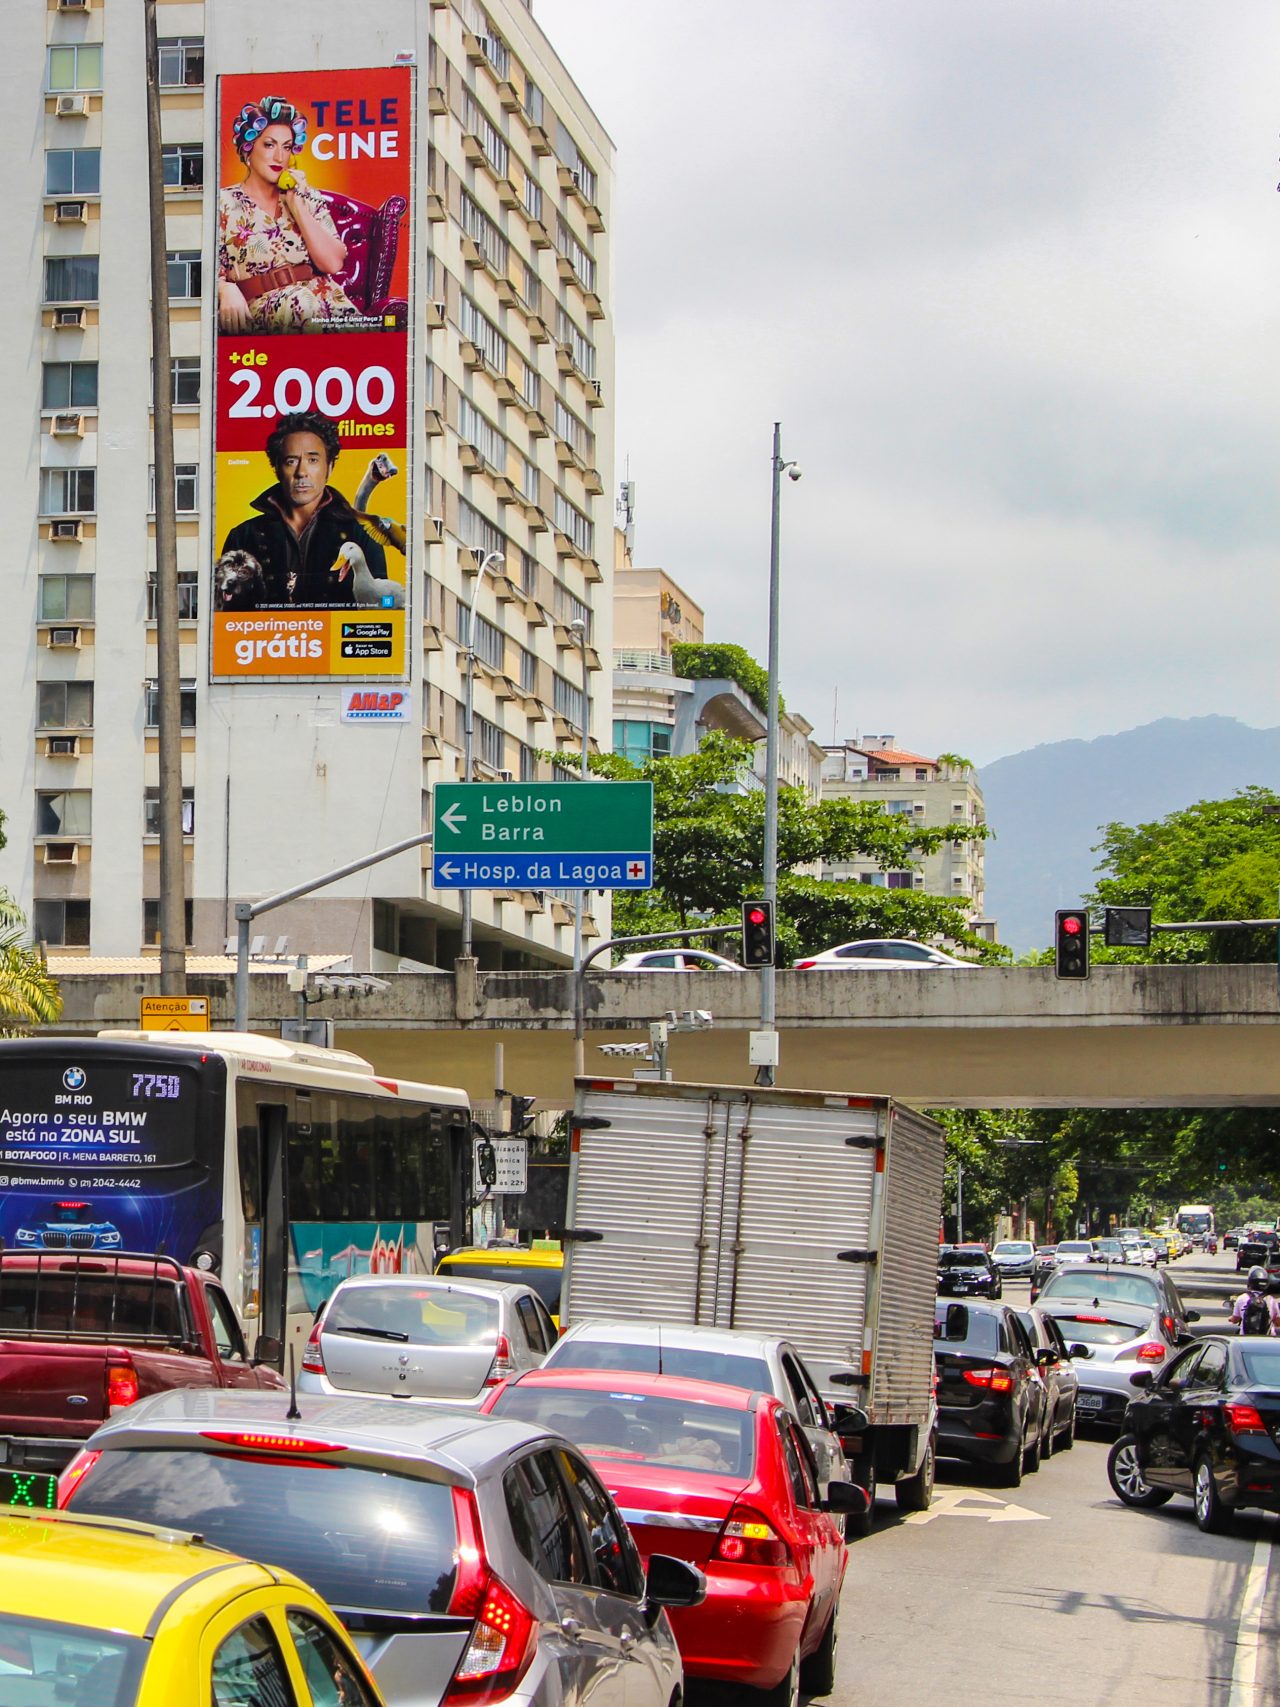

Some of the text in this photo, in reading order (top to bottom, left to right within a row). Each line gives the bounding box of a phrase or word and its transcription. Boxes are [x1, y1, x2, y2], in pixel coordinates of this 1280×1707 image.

[311, 97, 399, 127] TELE
[311, 130, 399, 161] CINE
[228, 365, 395, 419] 2.000
[337, 419, 395, 437] filmes
[225, 617, 323, 635] experimente
[356, 629, 377, 637] Google
[235, 632, 323, 665] grátis
[355, 647, 388, 656] App Store
[347, 692, 403, 711] AM&P
[482, 795, 562, 813] Leblon
[482, 823, 545, 841] Barra
[464, 862, 622, 883] Hosp. da Lagoa
[145, 1002, 187, 1013] Atenção
[55, 1095, 93, 1105] BM RIO
[0, 1109, 147, 1127] Agora o seu BMW
[5, 1128, 141, 1144] está na ZONA SUL
[5, 1150, 57, 1160] BOTAFOGO
[63, 1152, 71, 1160] R.
[72, 1152, 98, 1161] MENA
[99, 1153, 142, 1163] BARRETO,
[144, 1154, 156, 1163] 161
[10, 1177, 65, 1186] @bmw.bmrio
[93, 1178, 141, 1188] 2042-4442
